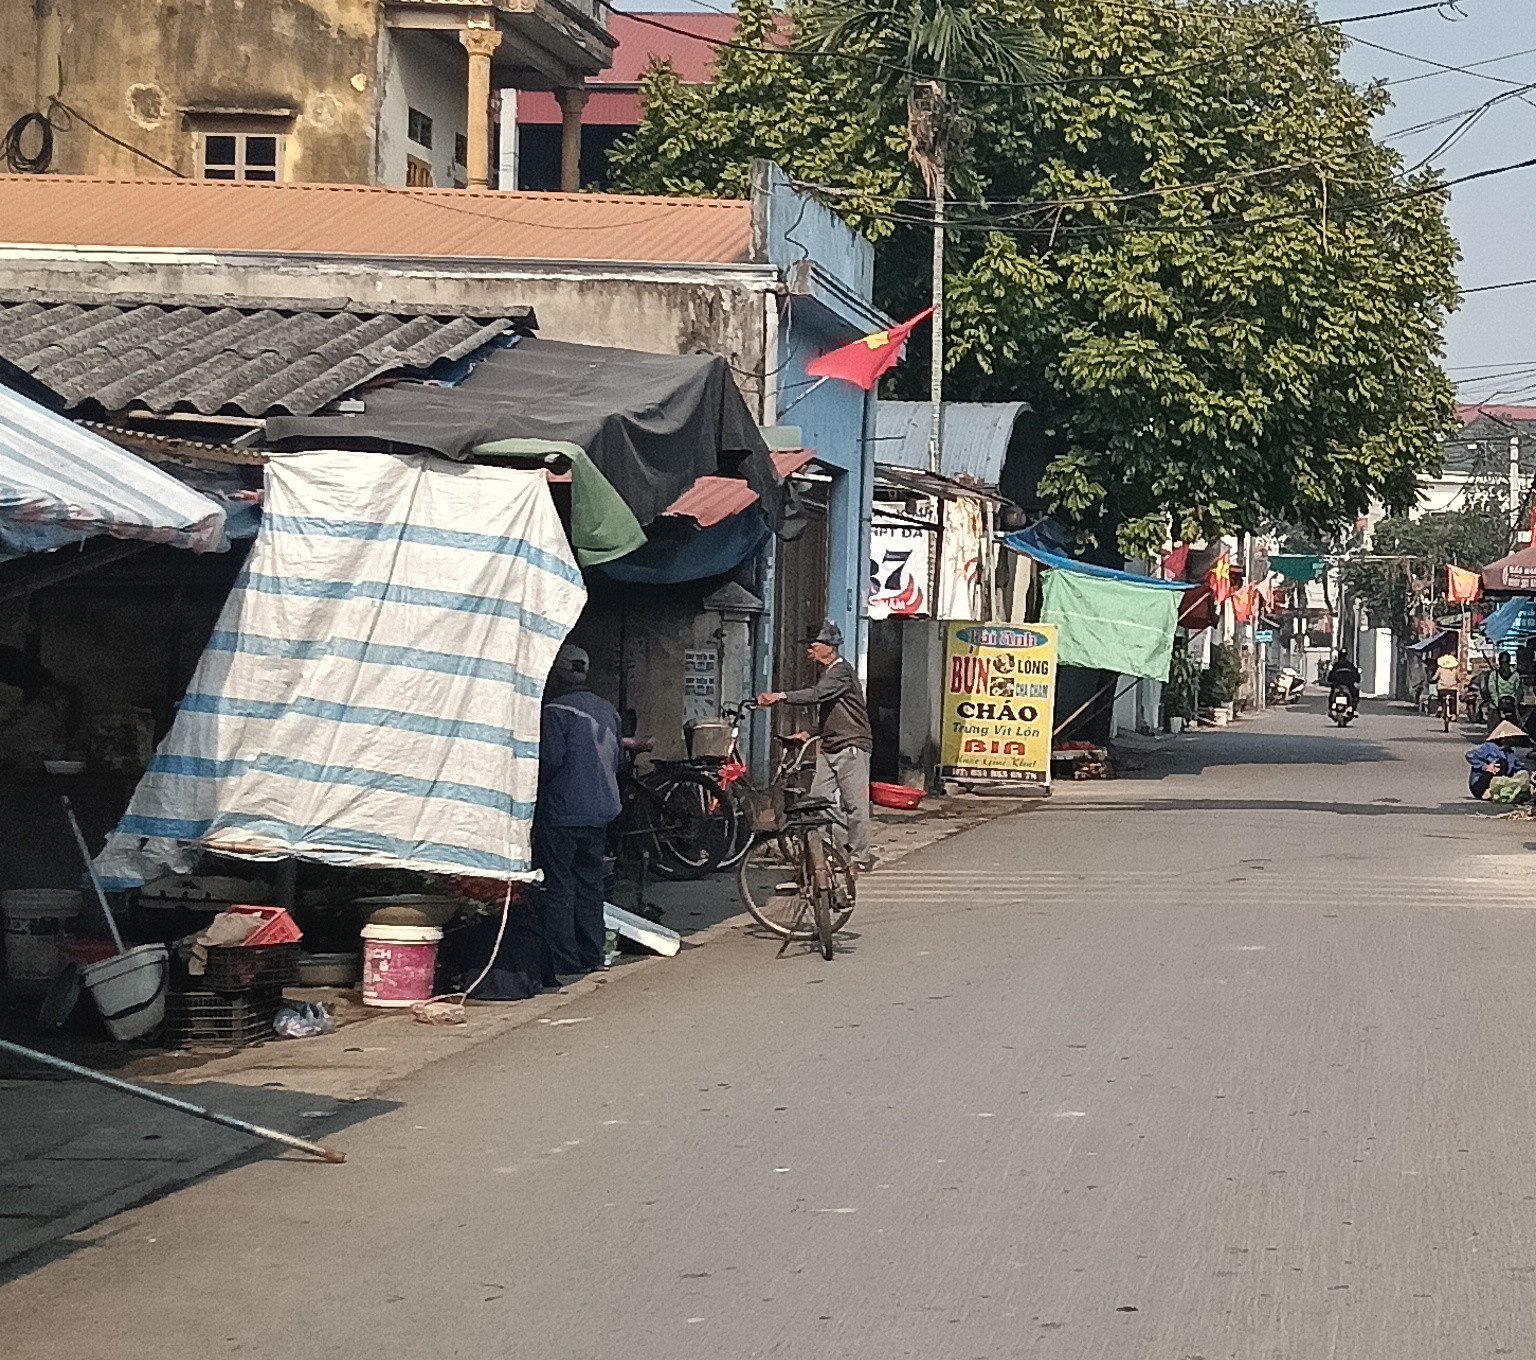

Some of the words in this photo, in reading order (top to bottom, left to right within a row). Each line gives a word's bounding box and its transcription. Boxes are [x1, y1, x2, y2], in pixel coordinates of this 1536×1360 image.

[950, 645, 990, 695] BÚN
[957, 700, 1038, 721] CHÁO
[964, 738, 1026, 756] BIA
